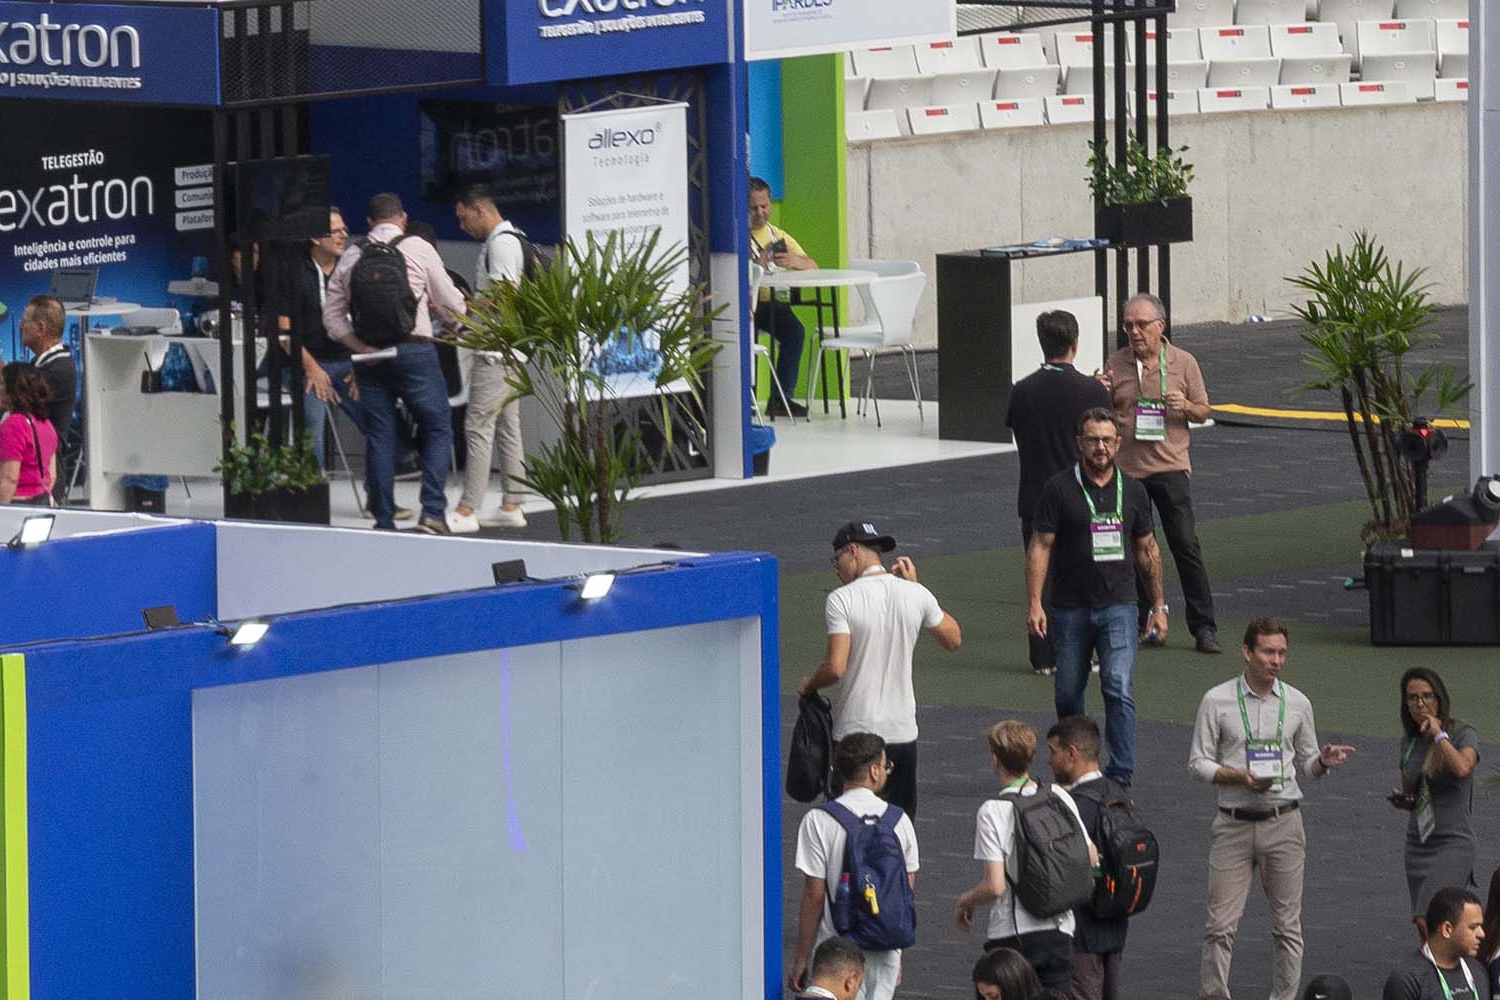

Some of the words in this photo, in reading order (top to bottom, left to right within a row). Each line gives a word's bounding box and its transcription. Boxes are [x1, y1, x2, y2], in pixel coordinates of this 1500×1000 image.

[588, 128, 654, 149] allexo
[42, 149, 104, 170] TELEGESTÃO
[182, 214, 214, 225] Platafor
[14, 239, 67, 256] Inteligência
[68, 241, 74, 250] e
[76, 235, 113, 250] controle
[115, 234, 136, 248] para
[24, 257, 58, 272] cidades
[60, 253, 81, 266] mais
[83, 251, 126, 265] eficientes
